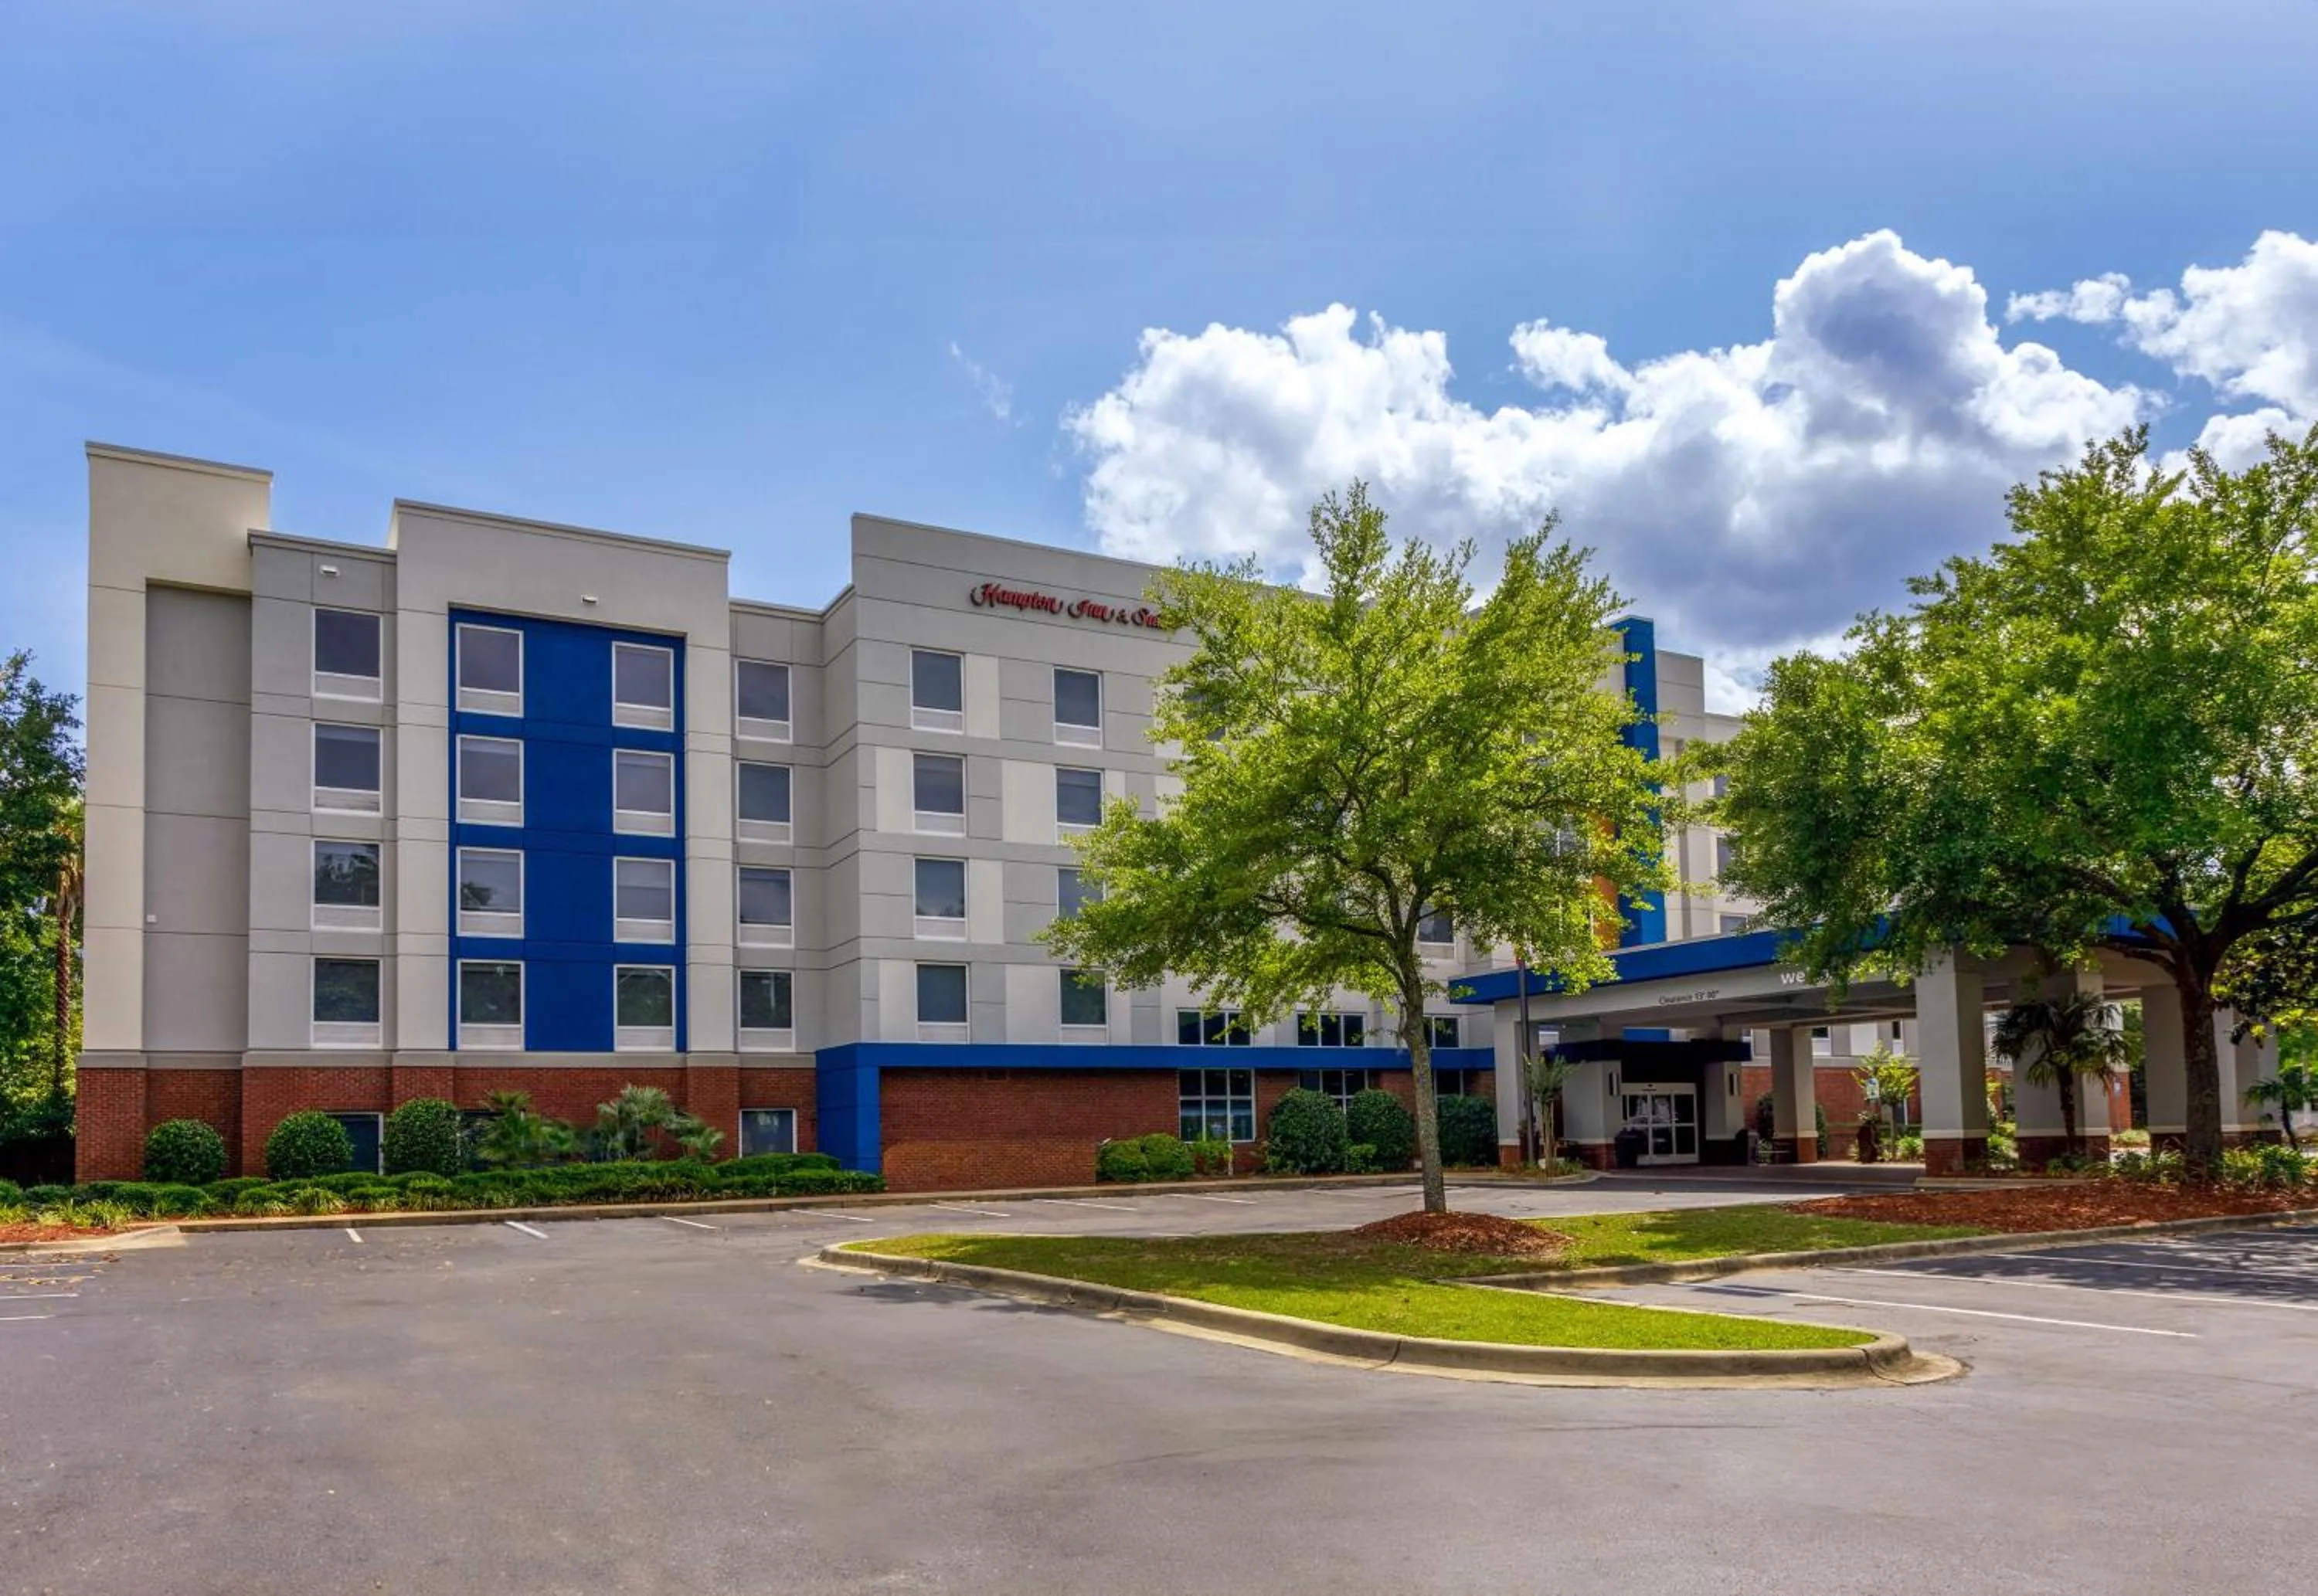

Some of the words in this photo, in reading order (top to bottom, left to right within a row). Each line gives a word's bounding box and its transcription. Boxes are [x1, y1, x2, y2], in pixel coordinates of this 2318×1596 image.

[970, 583, 1063, 614] Hampton
[1068, 599, 1114, 623] Inn
[1116, 608, 1128, 624] &
[1658, 993, 1693, 1005] Clearance
